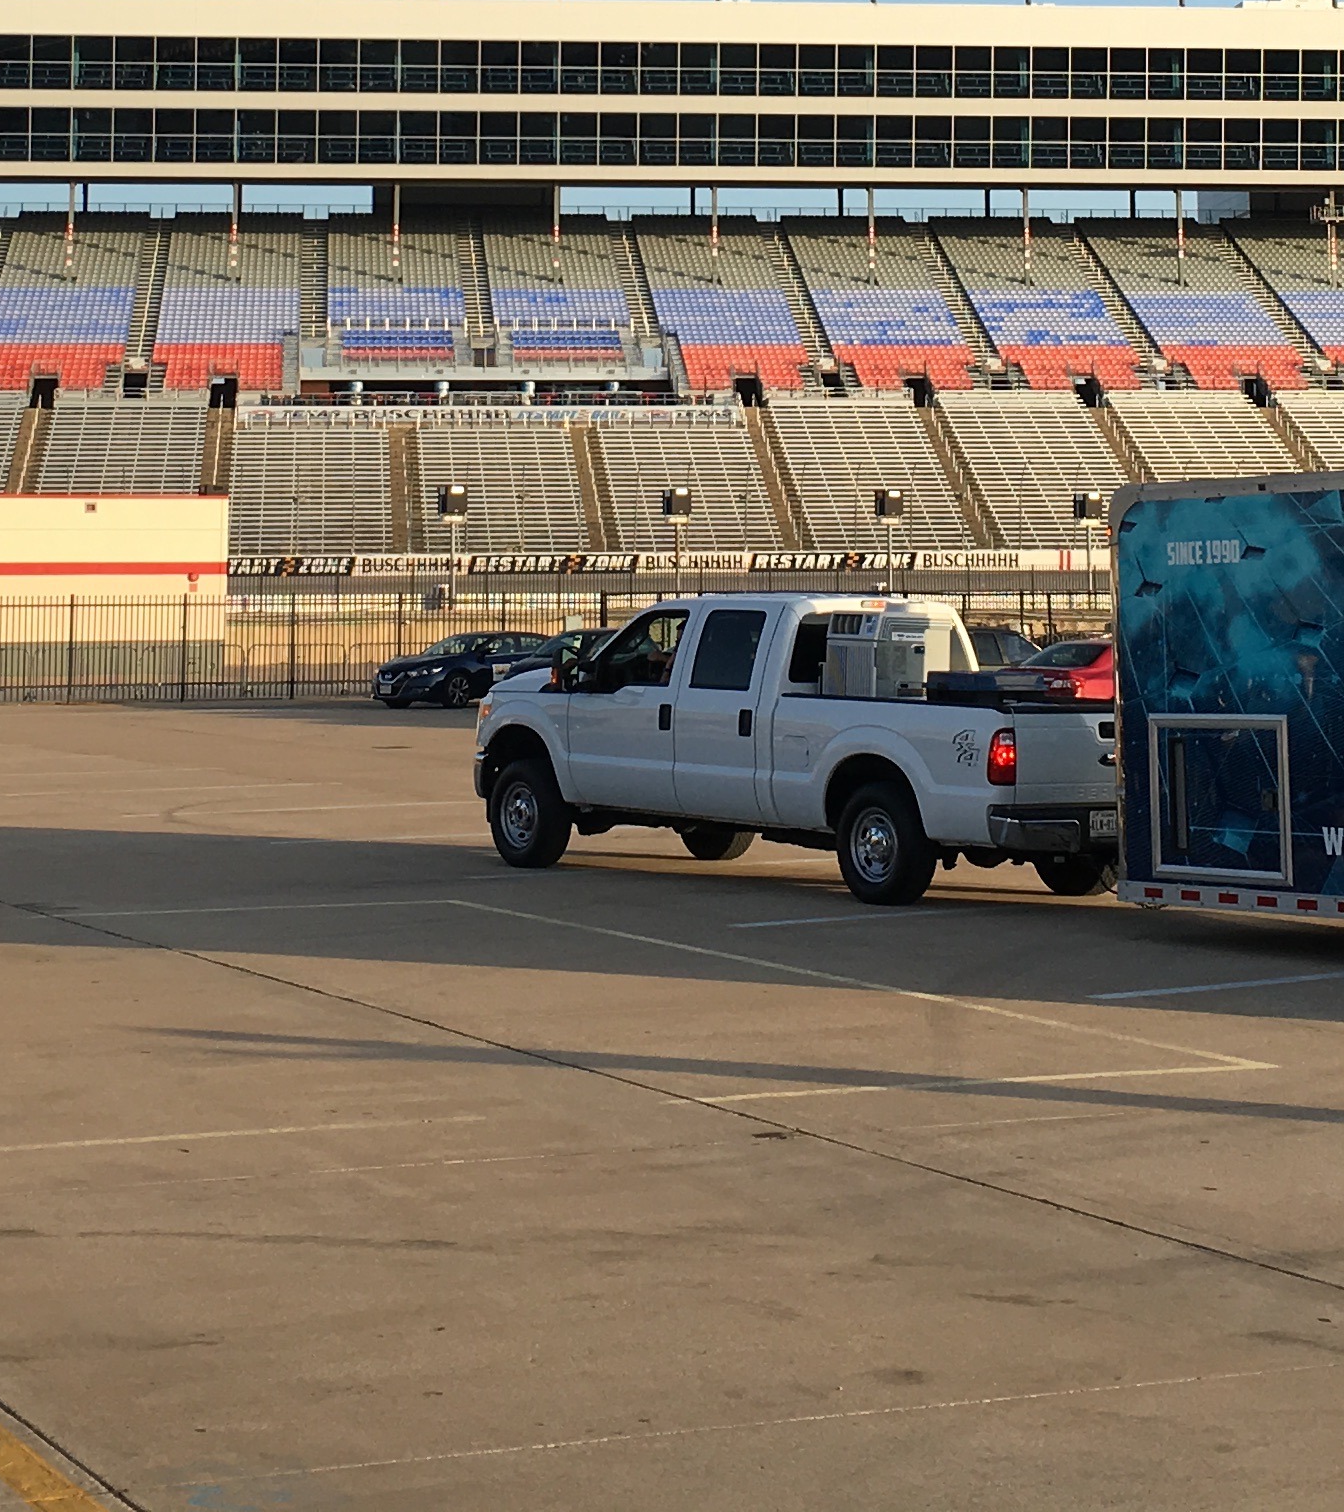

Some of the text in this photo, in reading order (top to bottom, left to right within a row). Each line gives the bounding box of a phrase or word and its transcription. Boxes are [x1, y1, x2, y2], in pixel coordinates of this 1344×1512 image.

[922, 552, 1019, 569] BUSCHHHHH
[1167, 539, 1241, 565] SINCE 1990
[472, 555, 564, 572] RESTART
[755, 553, 912, 570] RESTART ZONE
